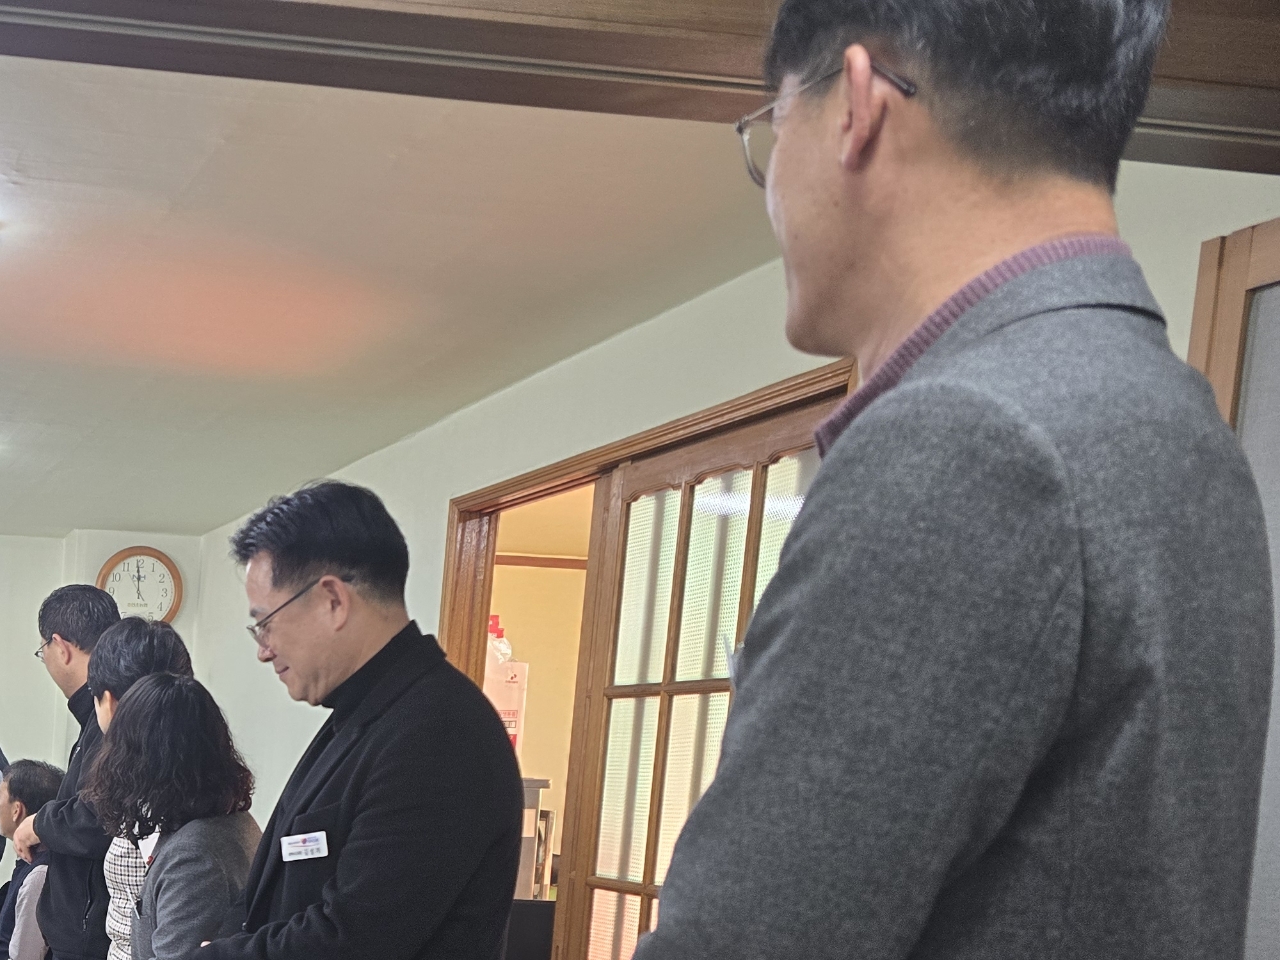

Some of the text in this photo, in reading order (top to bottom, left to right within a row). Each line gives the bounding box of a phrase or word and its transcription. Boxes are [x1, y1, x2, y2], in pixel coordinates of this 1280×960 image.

[122, 562, 130, 572] 11
[136, 559, 145, 568] 12
[152, 563, 155, 572] 1
[112, 572, 121, 582] 10
[159, 574, 165, 583] 2
[161, 588, 168, 597] 3
[157, 602, 163, 611] 4
